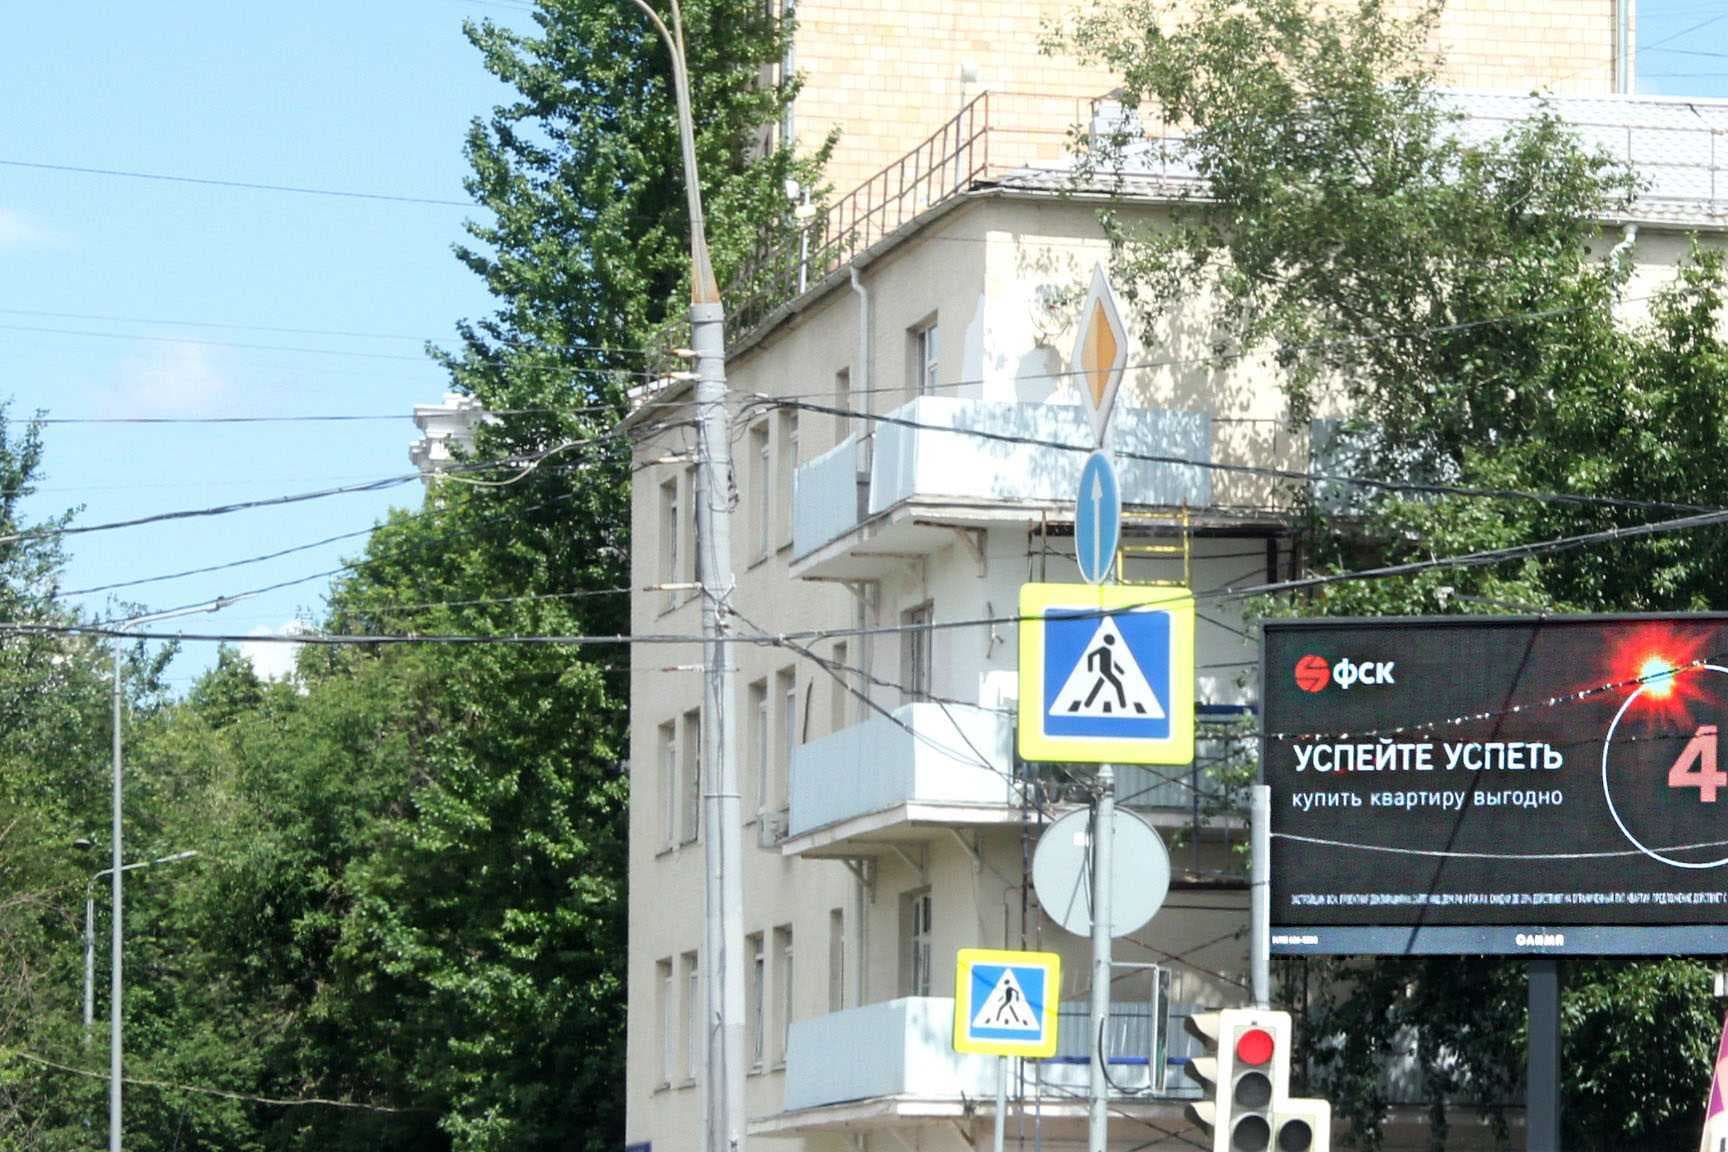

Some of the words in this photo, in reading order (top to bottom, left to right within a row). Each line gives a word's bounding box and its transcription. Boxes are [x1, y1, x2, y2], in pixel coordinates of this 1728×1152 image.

[1332, 657, 1395, 689] ФСК
[1292, 738, 1434, 772] УСПЕЙТЕ
[1443, 742, 1563, 771] УСПЕТЬ
[1667, 725, 1727, 802] 4
[1292, 791, 1362, 811] купить
[1370, 791, 1465, 810] квартиру
[1474, 789, 1563, 809] выгодно
